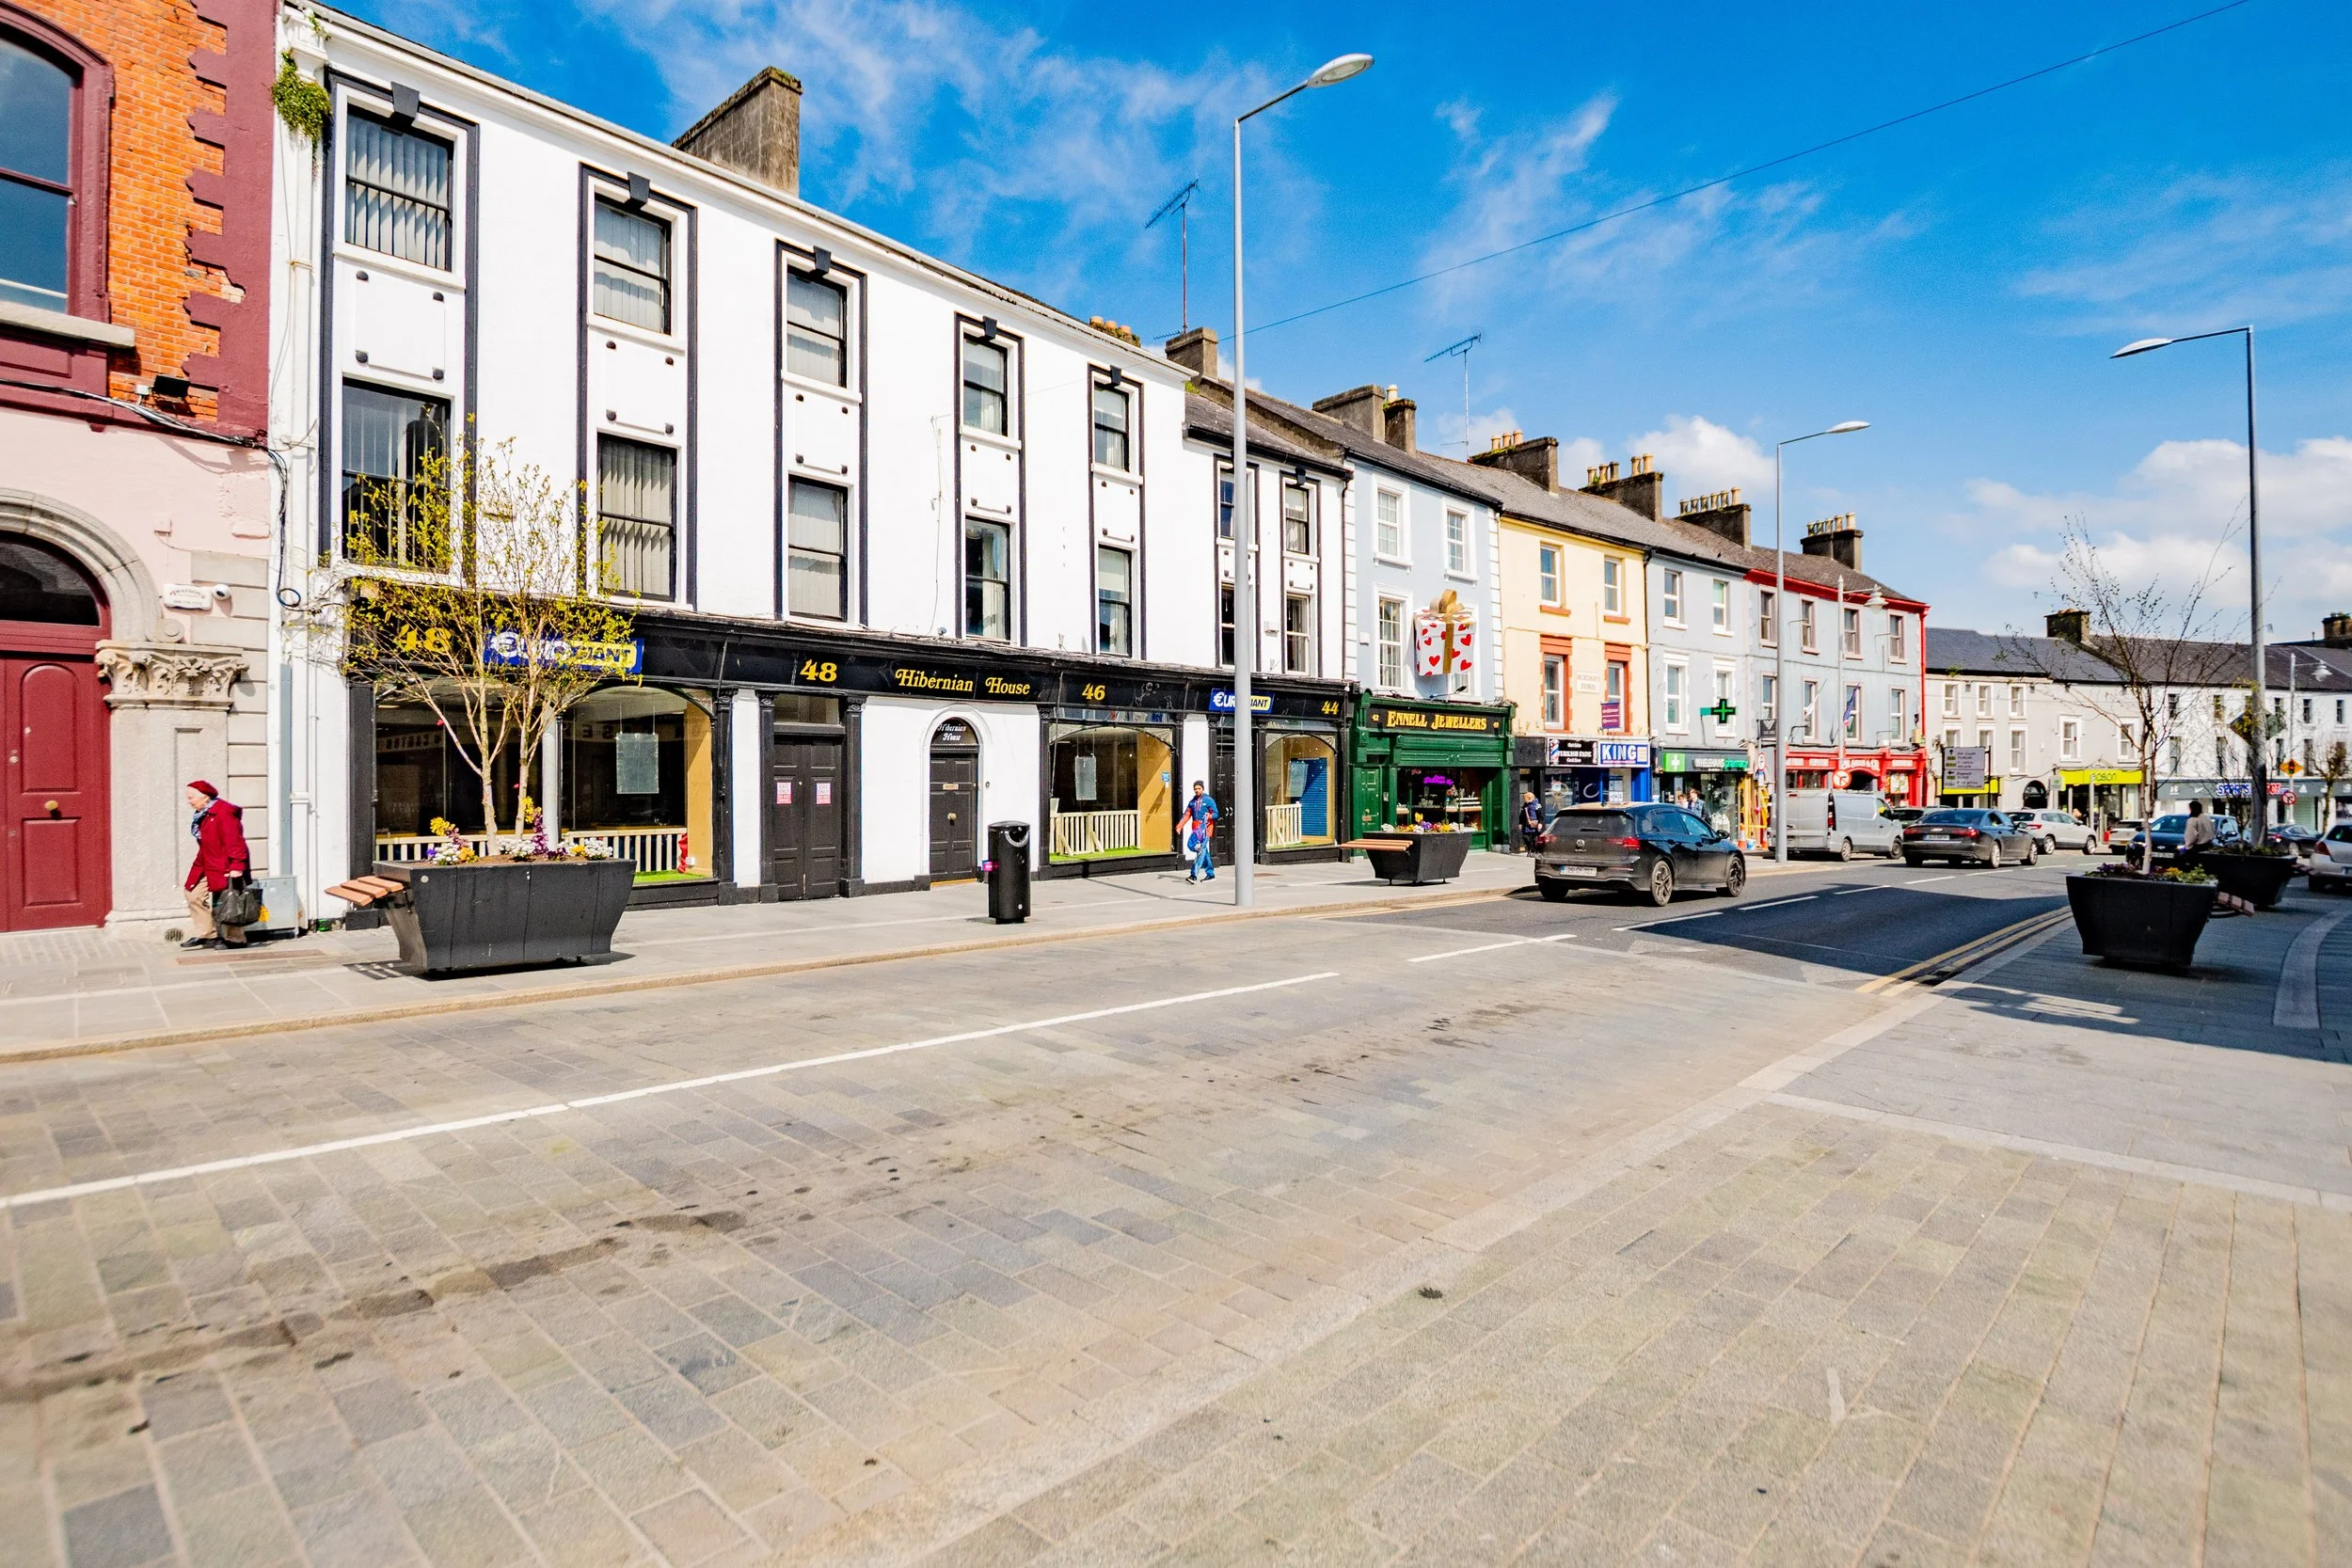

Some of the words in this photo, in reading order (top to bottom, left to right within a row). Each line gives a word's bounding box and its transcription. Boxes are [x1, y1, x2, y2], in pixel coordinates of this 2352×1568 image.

[393, 624, 452, 653] 48
[800, 659, 837, 682] 48
[895, 668, 974, 692] Hibernian
[985, 676, 1031, 695] House
[1082, 683, 1105, 701] 46
[1321, 701, 1340, 715] 44
[937, 723, 967, 732] Hibernian
[1387, 710, 1428, 728] ENNELL
[1431, 714, 1487, 730] JEWELLERS
[943, 733, 961, 741] House
[1602, 744, 1636, 760] KING
